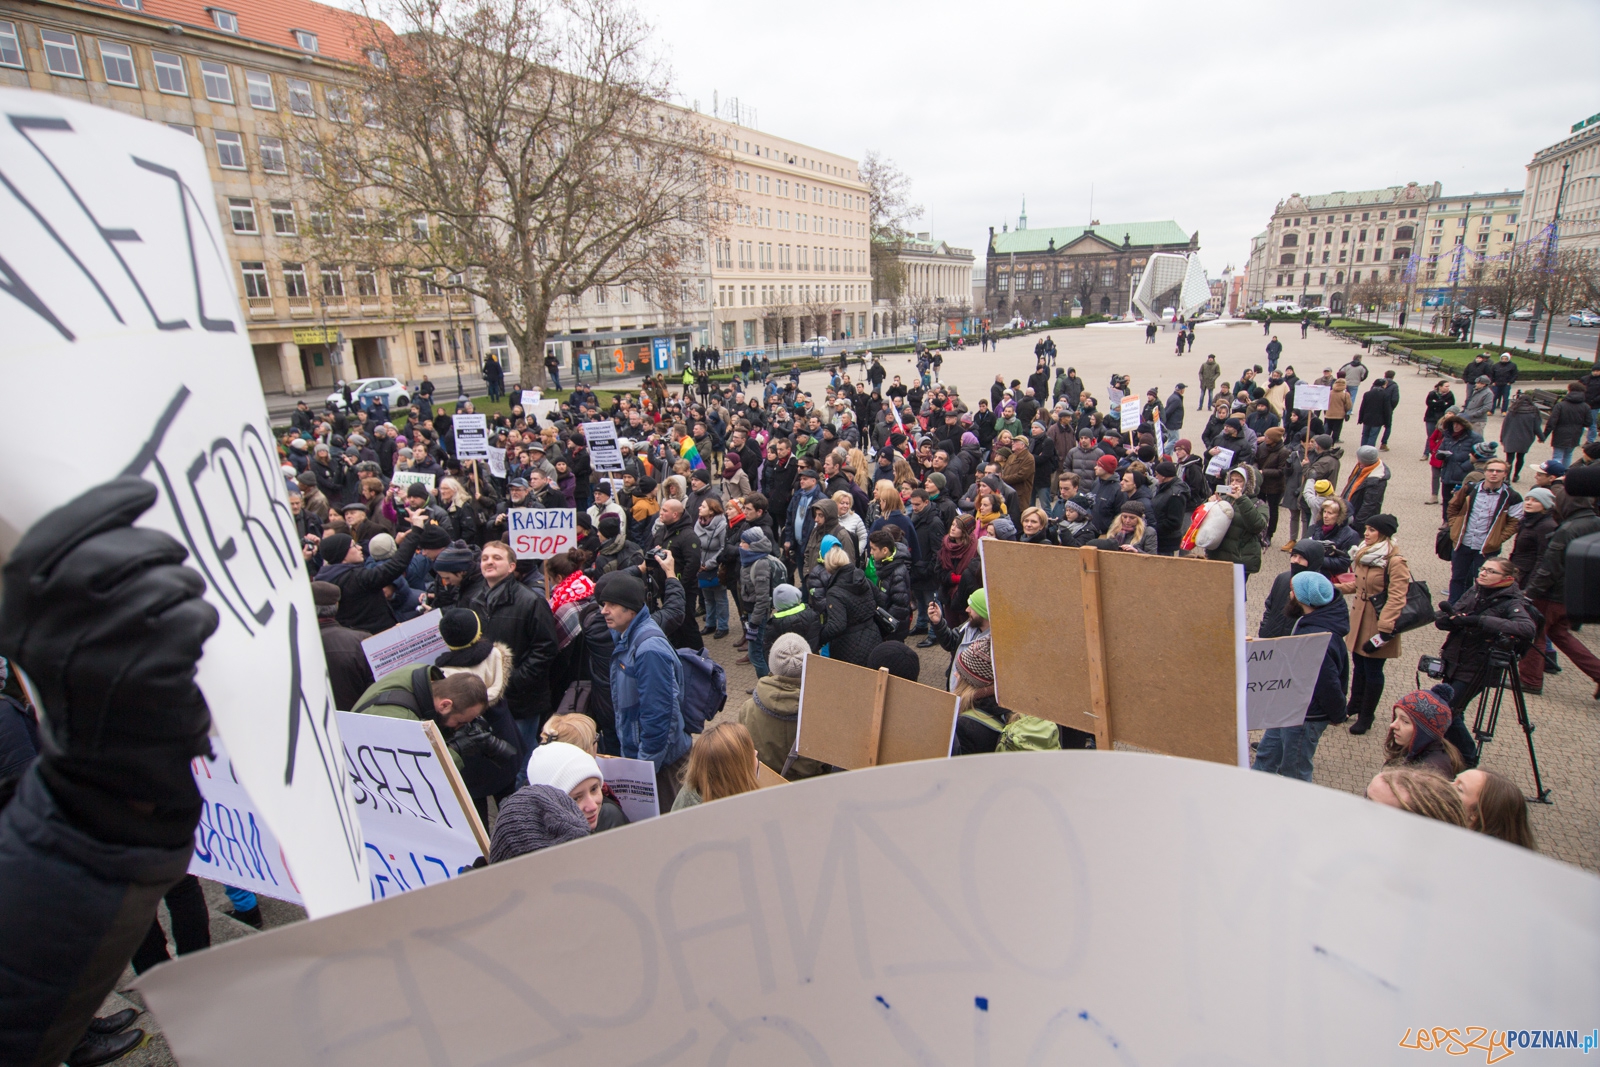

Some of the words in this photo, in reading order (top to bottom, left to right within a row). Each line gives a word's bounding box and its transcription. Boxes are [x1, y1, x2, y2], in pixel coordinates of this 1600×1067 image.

[614, 349, 625, 374] 3
[512, 511, 573, 530] RASIZM
[516, 535, 567, 554] STOP
[1248, 650, 1274, 662] AM
[1247, 679, 1291, 692] RYZM
